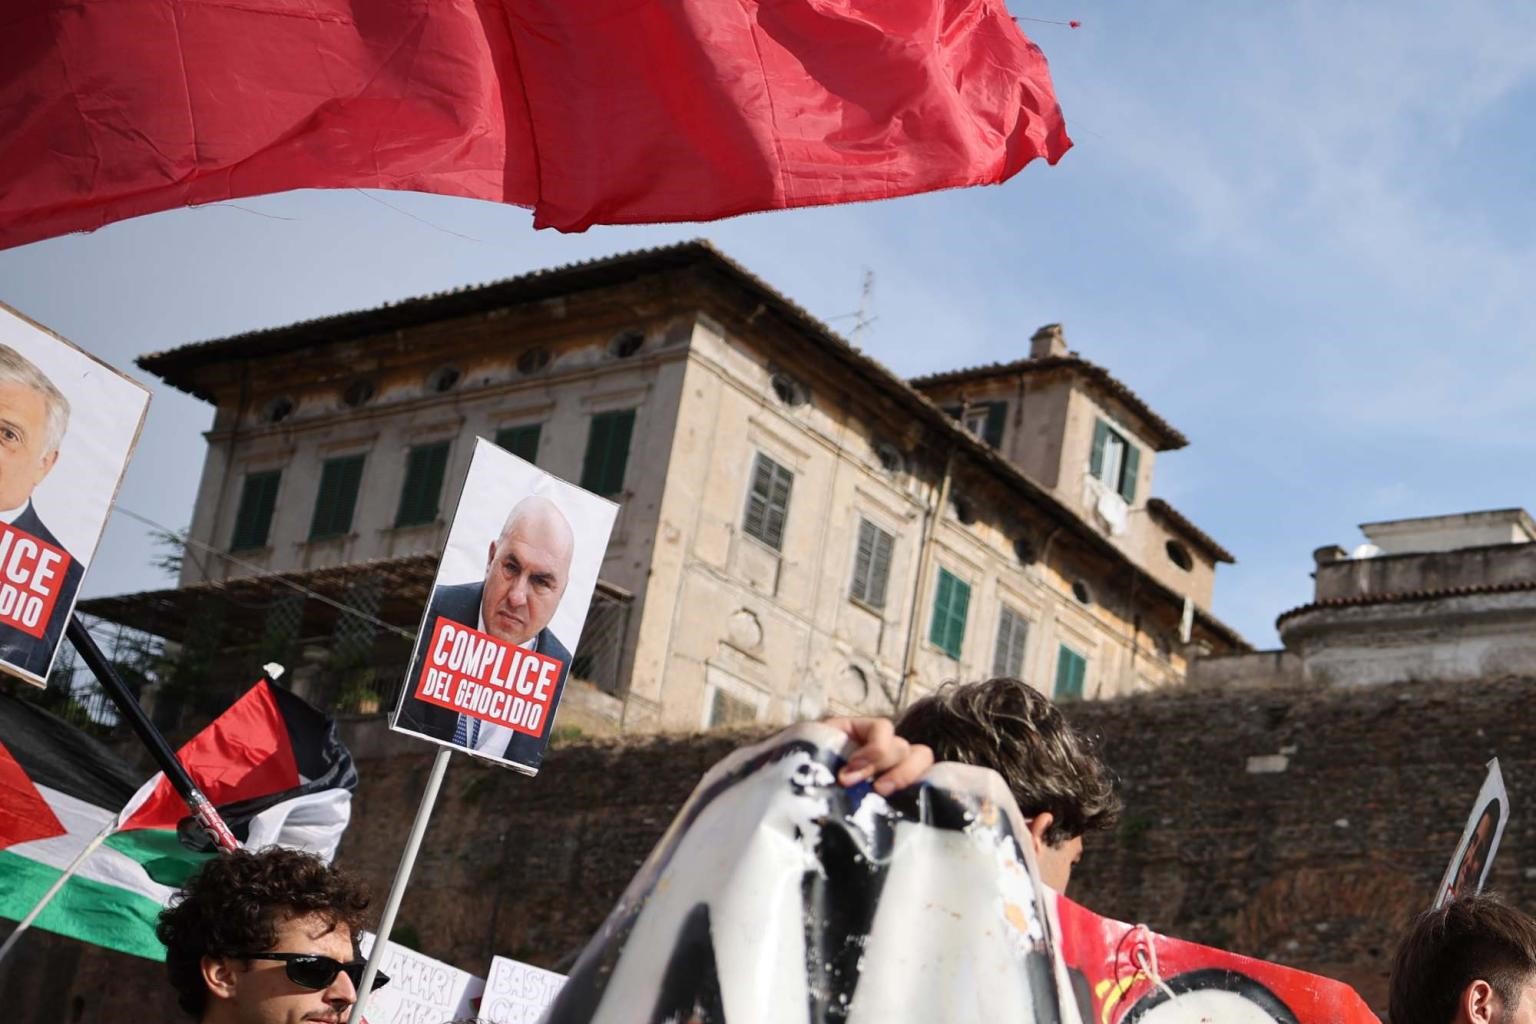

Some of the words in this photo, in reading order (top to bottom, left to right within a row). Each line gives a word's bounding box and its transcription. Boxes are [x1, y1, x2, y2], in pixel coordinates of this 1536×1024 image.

[432, 624, 557, 701] COMPLICE
[422, 667, 454, 703] DEL
[454, 678, 543, 731] GENOCIDIO
[491, 960, 565, 1008] BAST
